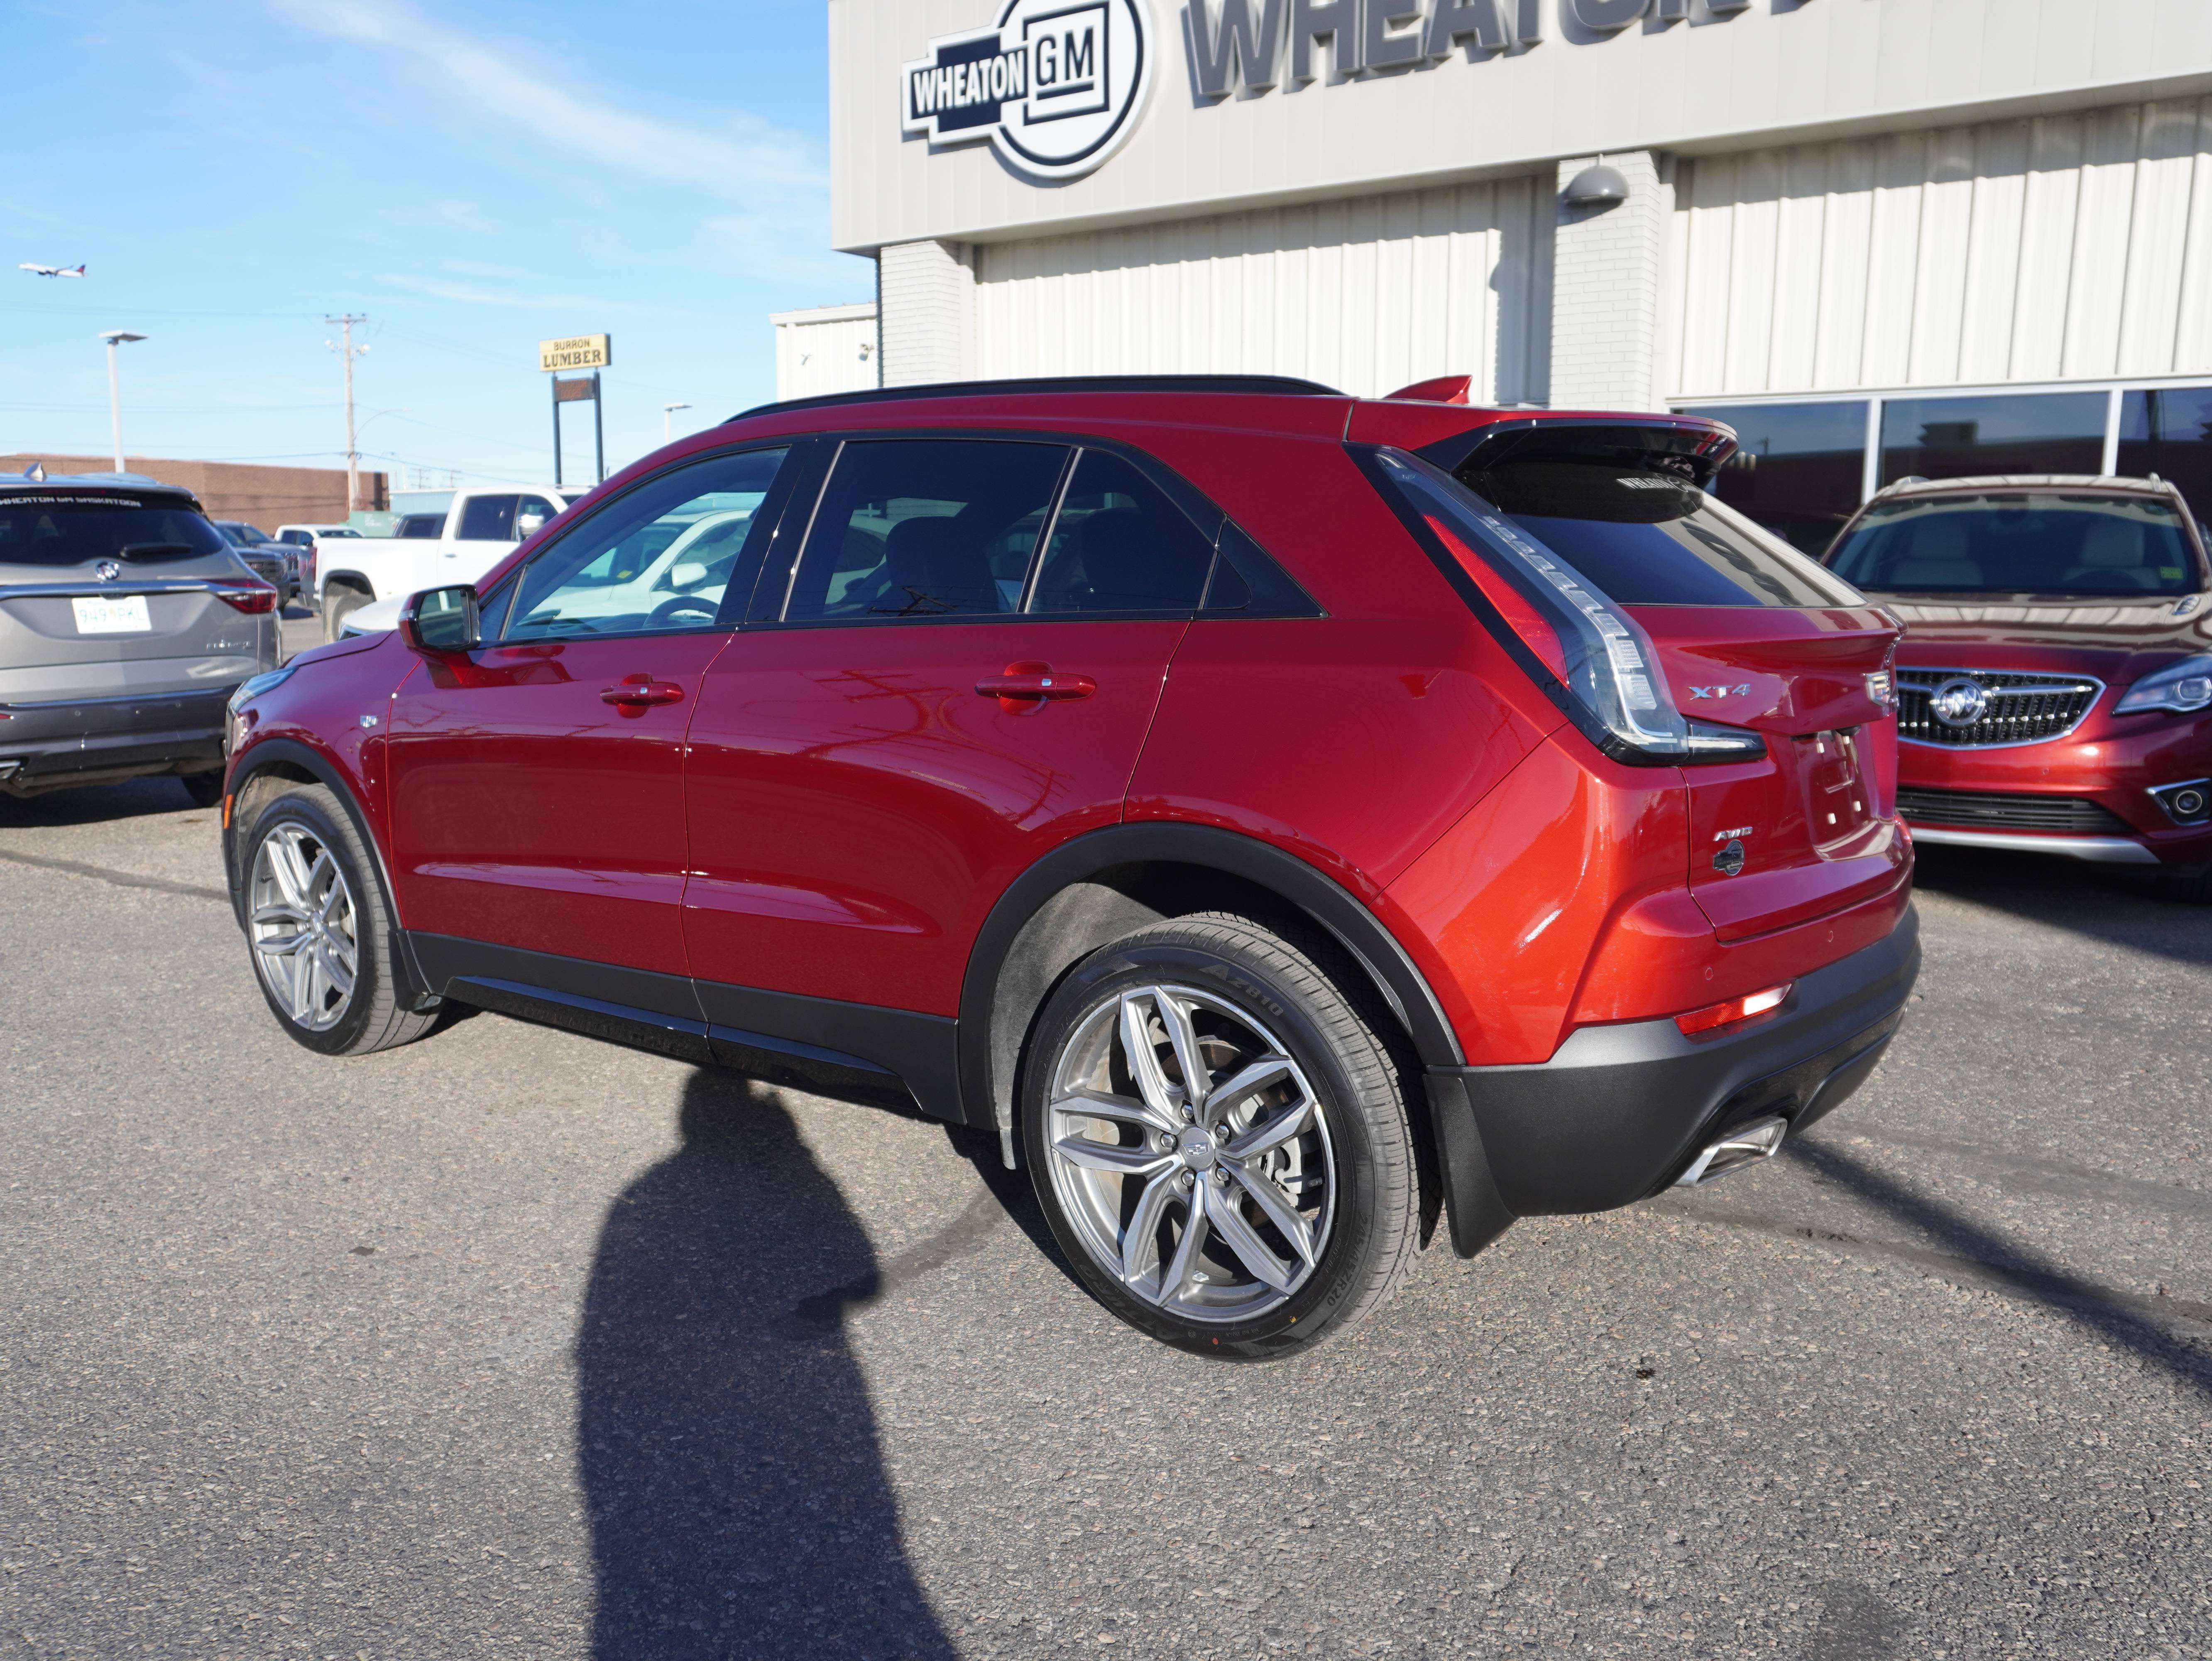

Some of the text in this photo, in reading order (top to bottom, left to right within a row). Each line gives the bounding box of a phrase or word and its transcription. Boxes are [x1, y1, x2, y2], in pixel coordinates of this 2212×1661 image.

[913, 28, 1093, 115] WHEATON GM
[553, 338, 590, 351] BURRON
[543, 349, 601, 368] LUMBER
[79, 606, 144, 623] 949 PKL
[1688, 683, 1751, 701] XT4
[1198, 964, 1284, 1017] AZ810
